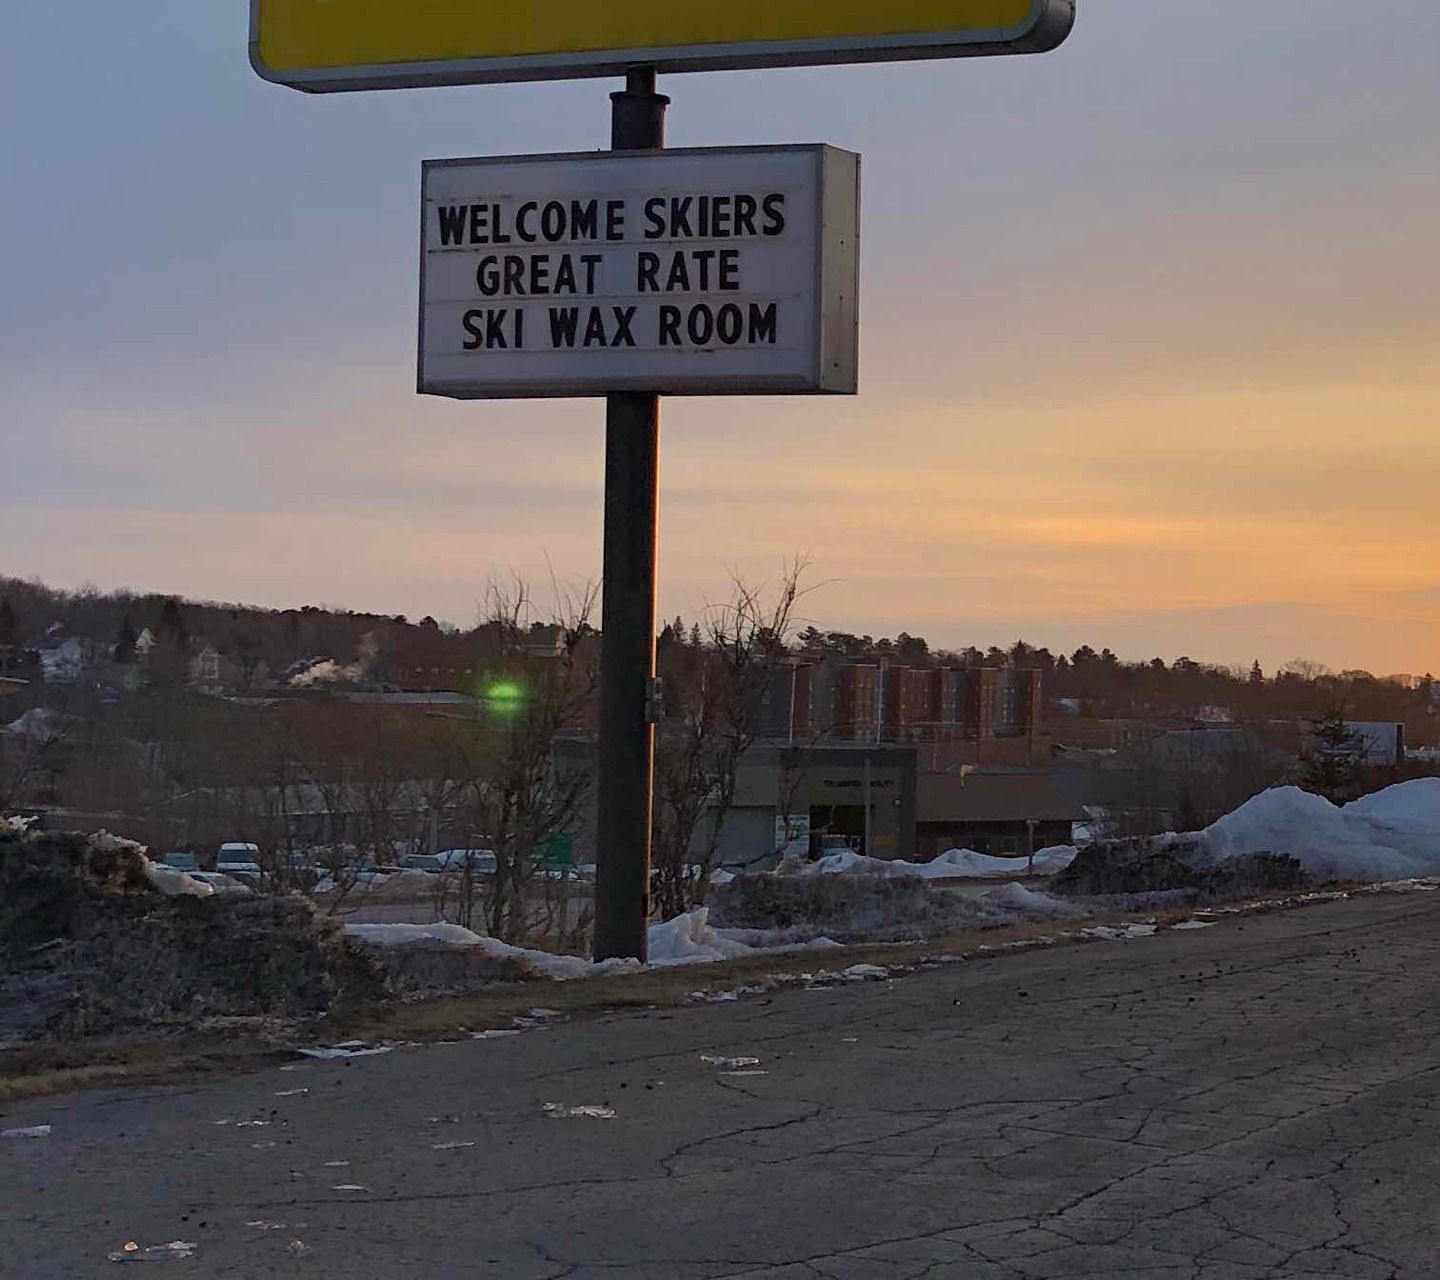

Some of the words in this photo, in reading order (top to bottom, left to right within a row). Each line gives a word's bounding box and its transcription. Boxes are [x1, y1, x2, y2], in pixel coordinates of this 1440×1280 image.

[438, 199, 625, 246] WELCOME
[644, 193, 786, 239] SKIERS
[476, 254, 602, 296] GREAT
[637, 250, 740, 292] RATE
[462, 309, 524, 350] SKI
[548, 306, 638, 349] WAX
[659, 302, 777, 346] ROOM
